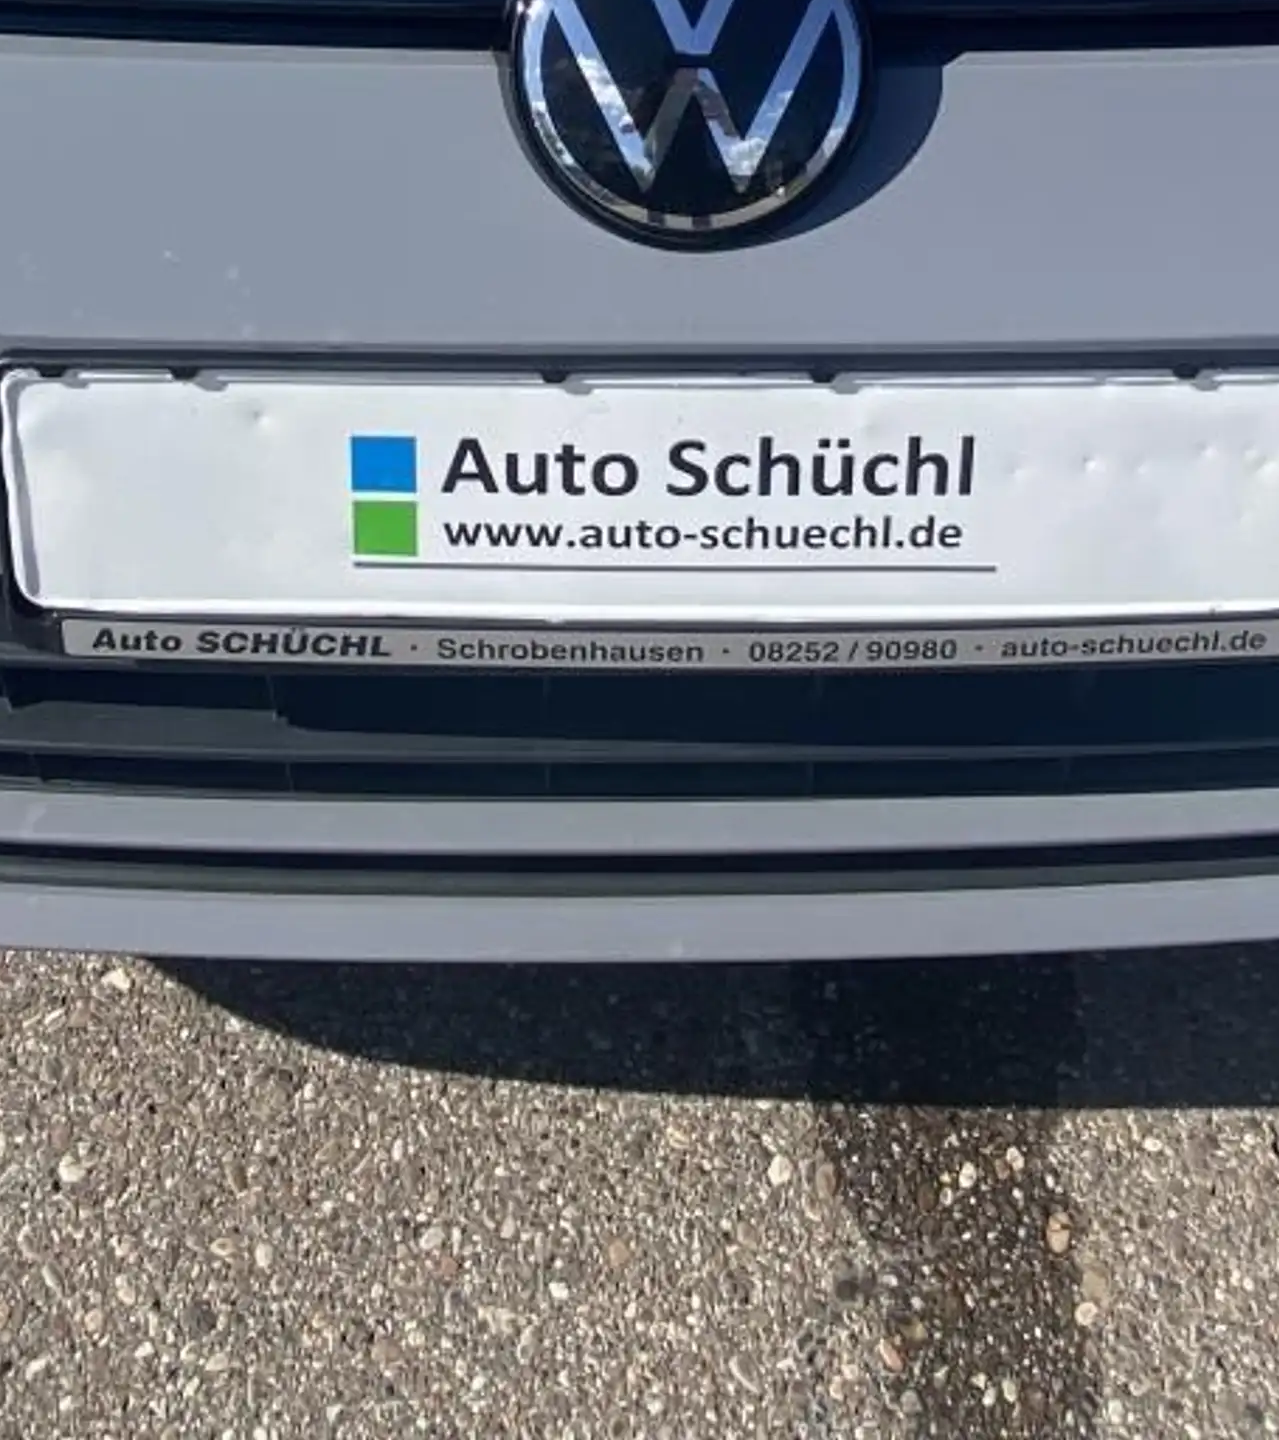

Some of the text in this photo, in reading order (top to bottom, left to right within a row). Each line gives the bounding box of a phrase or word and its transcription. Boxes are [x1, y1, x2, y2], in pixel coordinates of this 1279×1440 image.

[440, 435, 976, 498] Auto Schüchl
[442, 515, 963, 550] www.auto-schuechl.de
[91, 628, 183, 653] Auto
[195, 627, 392, 657] SCHÜCHL
[437, 638, 705, 663] Schrobenhausen
[1000, 630, 1268, 658] auto-schuechl.de
